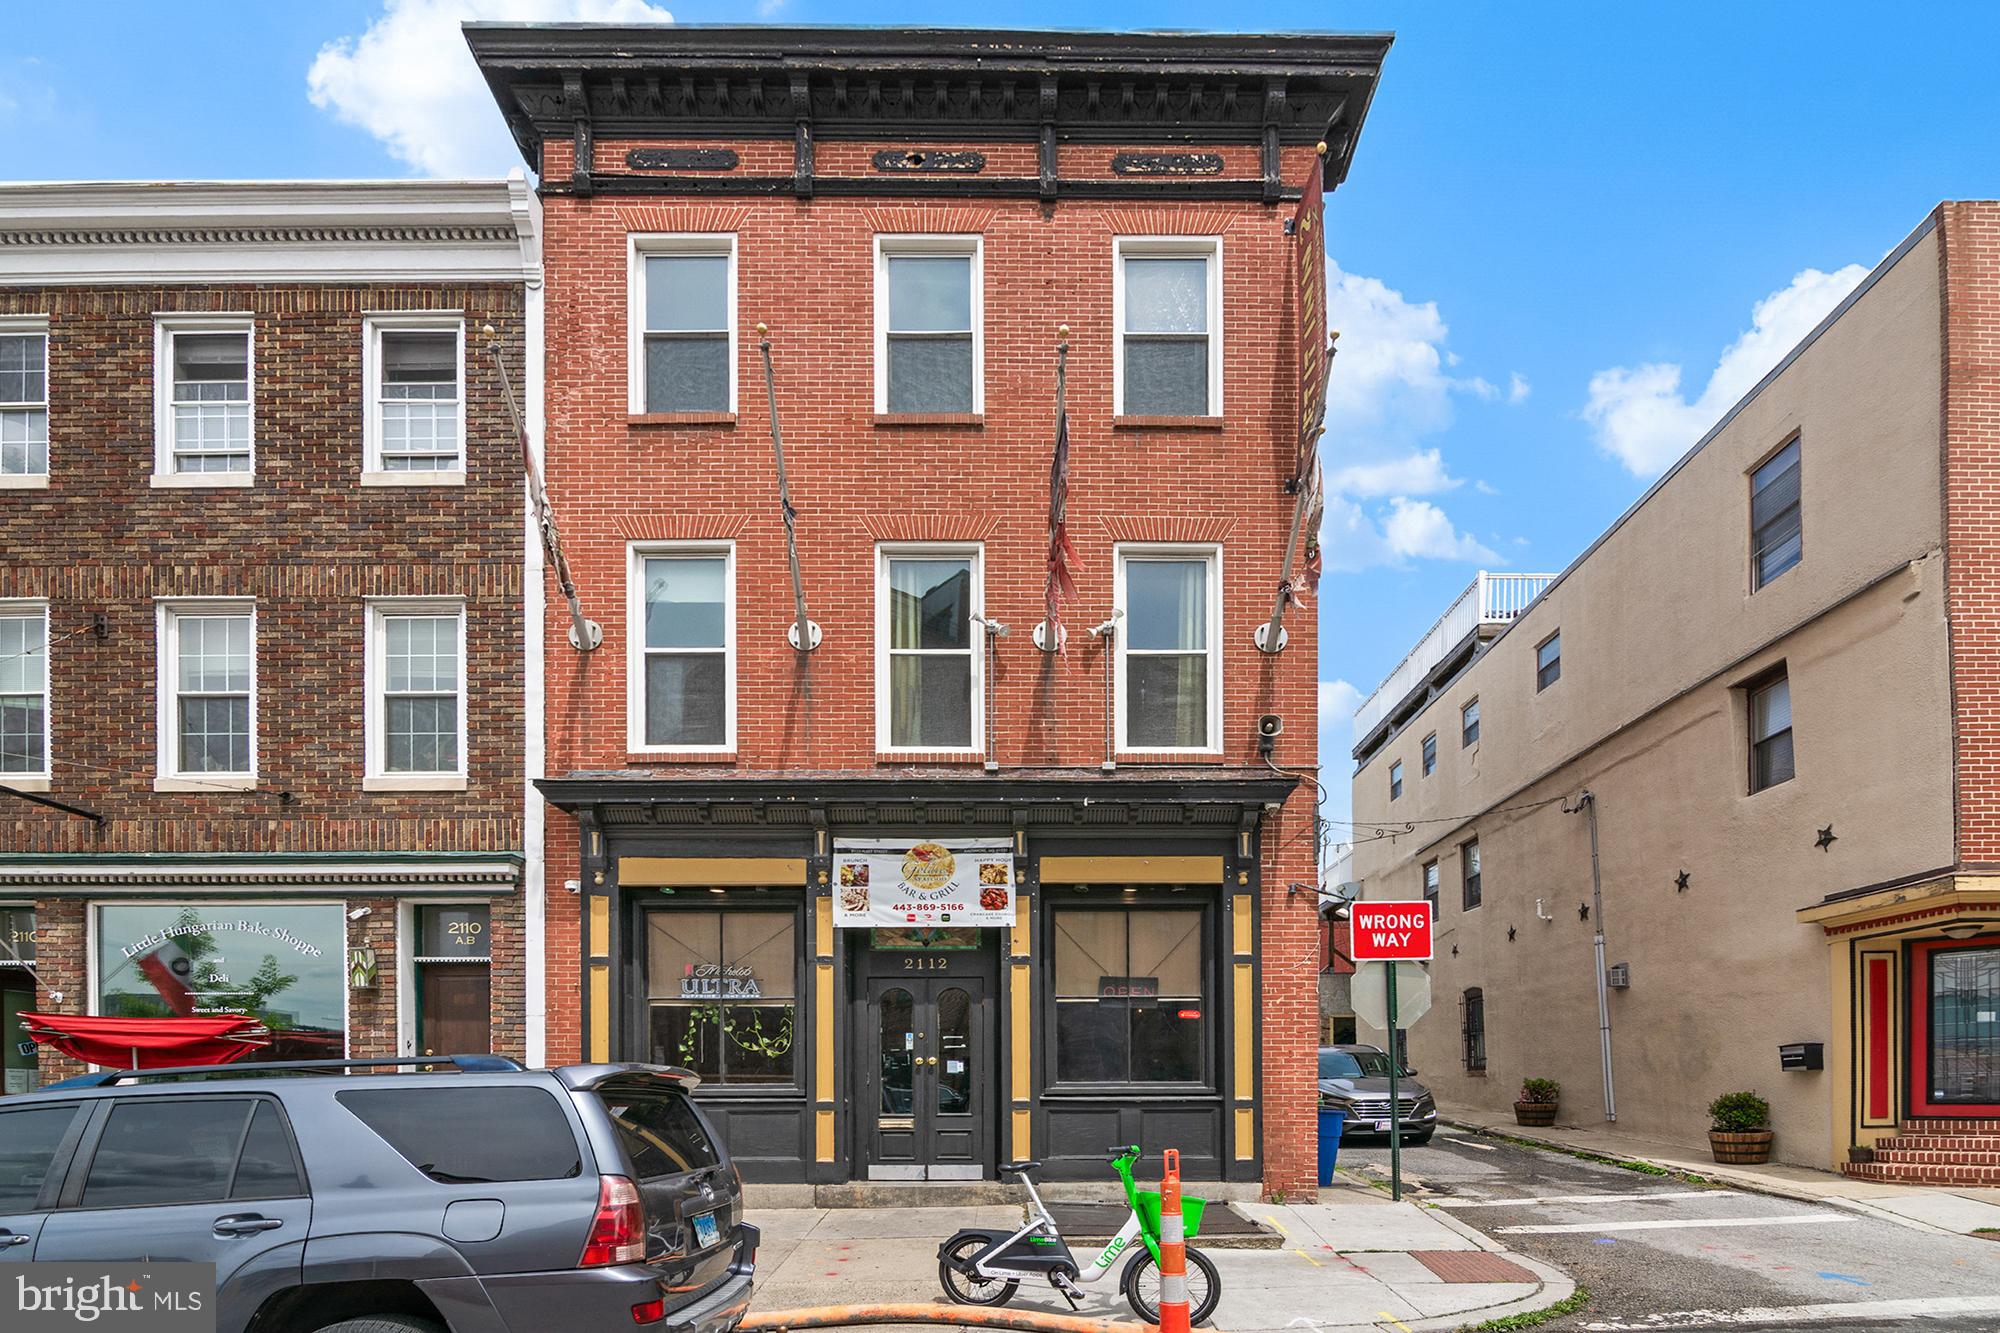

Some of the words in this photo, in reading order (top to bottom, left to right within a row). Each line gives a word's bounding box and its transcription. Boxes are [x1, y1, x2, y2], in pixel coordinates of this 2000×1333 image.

[897, 882, 916, 898] BAR
[919, 892, 926, 900] &
[929, 881, 960, 900] GRILL
[448, 922, 482, 934] 2110
[1359, 914, 1424, 929] WRONG
[121, 934, 160, 959] Little
[159, 921, 235, 939] Hungarian
[237, 920, 271, 937] Bake
[272, 928, 323, 958] Shoppe
[1372, 933, 1412, 947] WAY
[904, 958, 948, 969] 2112
[209, 974, 229, 983] Deli
[681, 978, 760, 994] ULTRA
[1095, 1237, 1126, 1268] Lime
